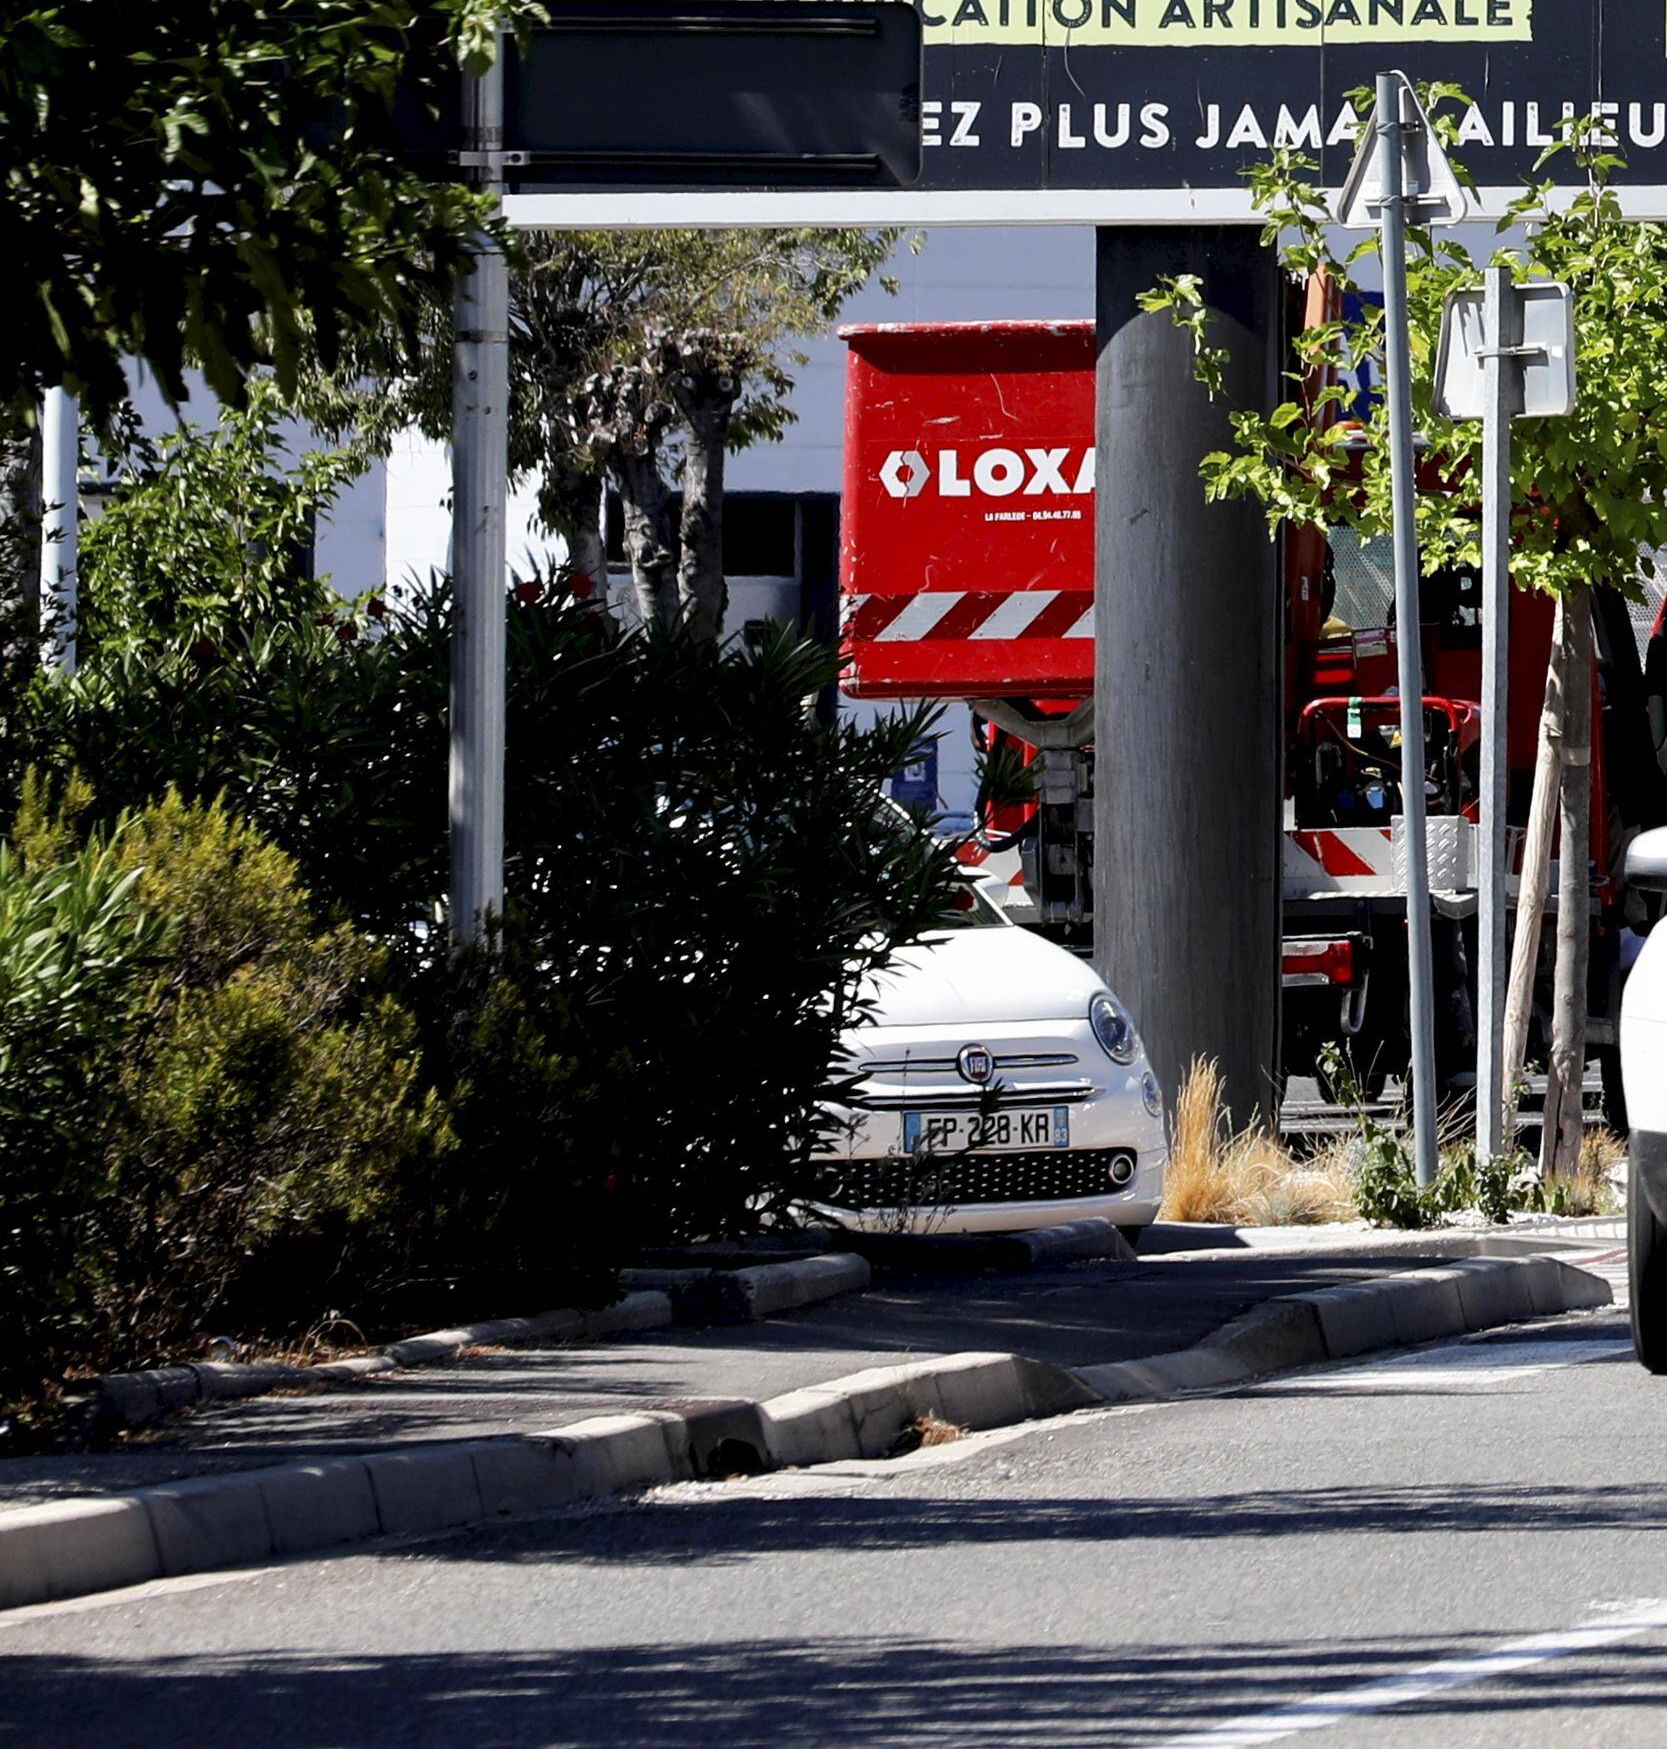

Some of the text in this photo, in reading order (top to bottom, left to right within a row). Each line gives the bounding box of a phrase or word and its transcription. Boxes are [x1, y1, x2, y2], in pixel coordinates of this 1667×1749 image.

[922, 101, 981, 147] EZ
[1011, 102, 1170, 149] PLUS
[1054, 1128, 1068, 1142] 83
